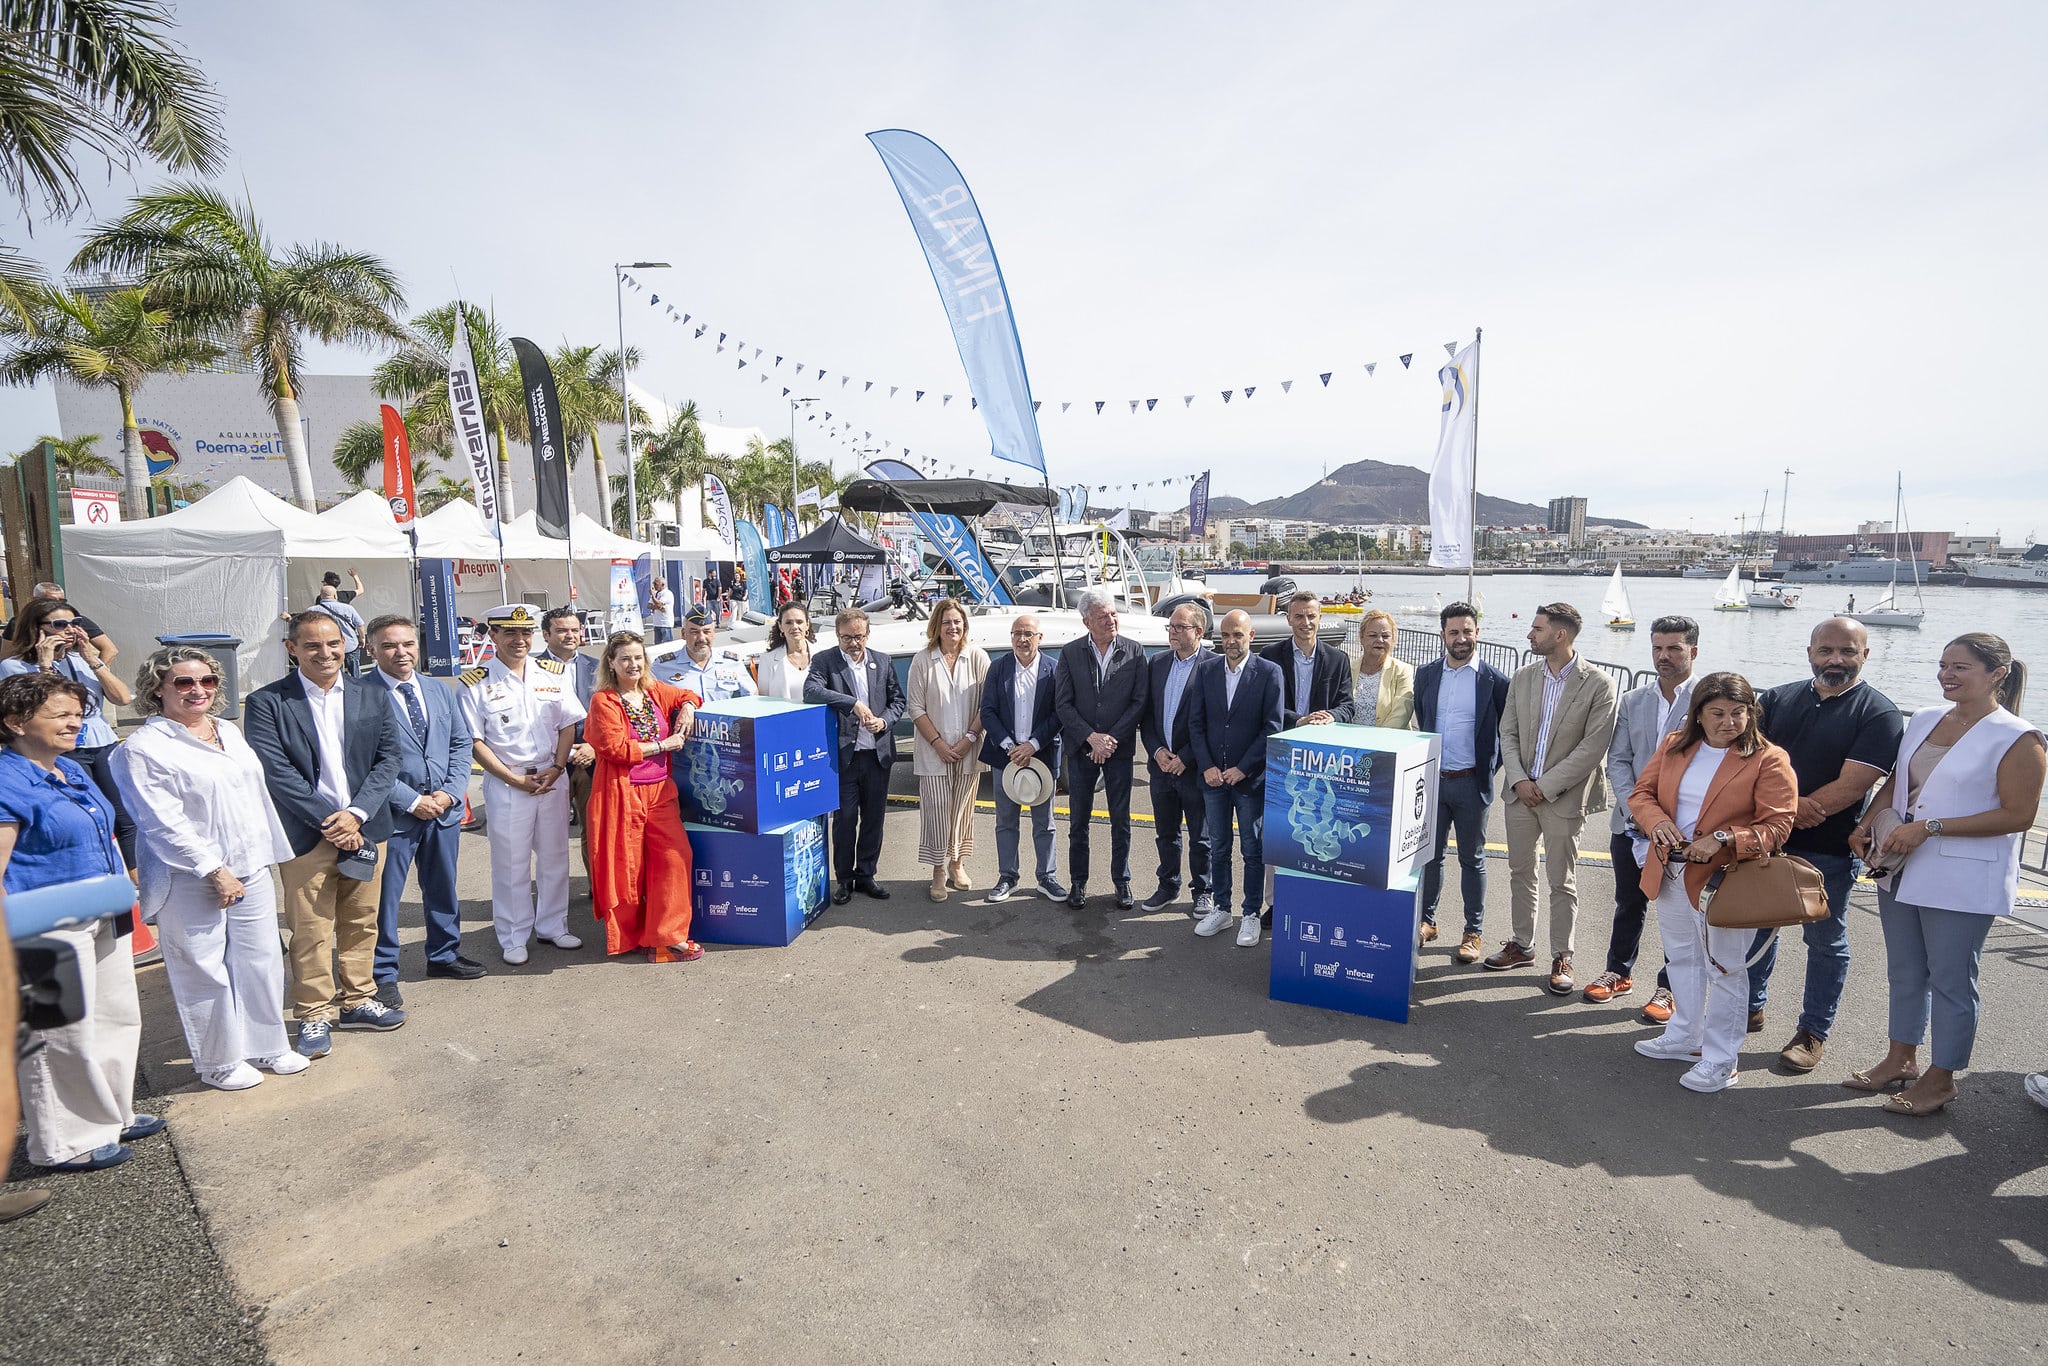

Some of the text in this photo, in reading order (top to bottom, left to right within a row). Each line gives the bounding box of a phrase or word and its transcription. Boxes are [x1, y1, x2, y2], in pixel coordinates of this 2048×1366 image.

[152, 418, 182, 441] NATURE
[196, 440, 249, 454] Poema
[694, 718, 729, 741] IMAR
[1291, 747, 1354, 777] FIMAR
[1356, 756, 1373, 768] 20
[1290, 769, 1305, 777] FERIA
[1354, 767, 1371, 780] 24
[793, 821, 818, 852] FIMAR
[734, 904, 759, 913] infecar
[1345, 967, 1375, 980] infecar
